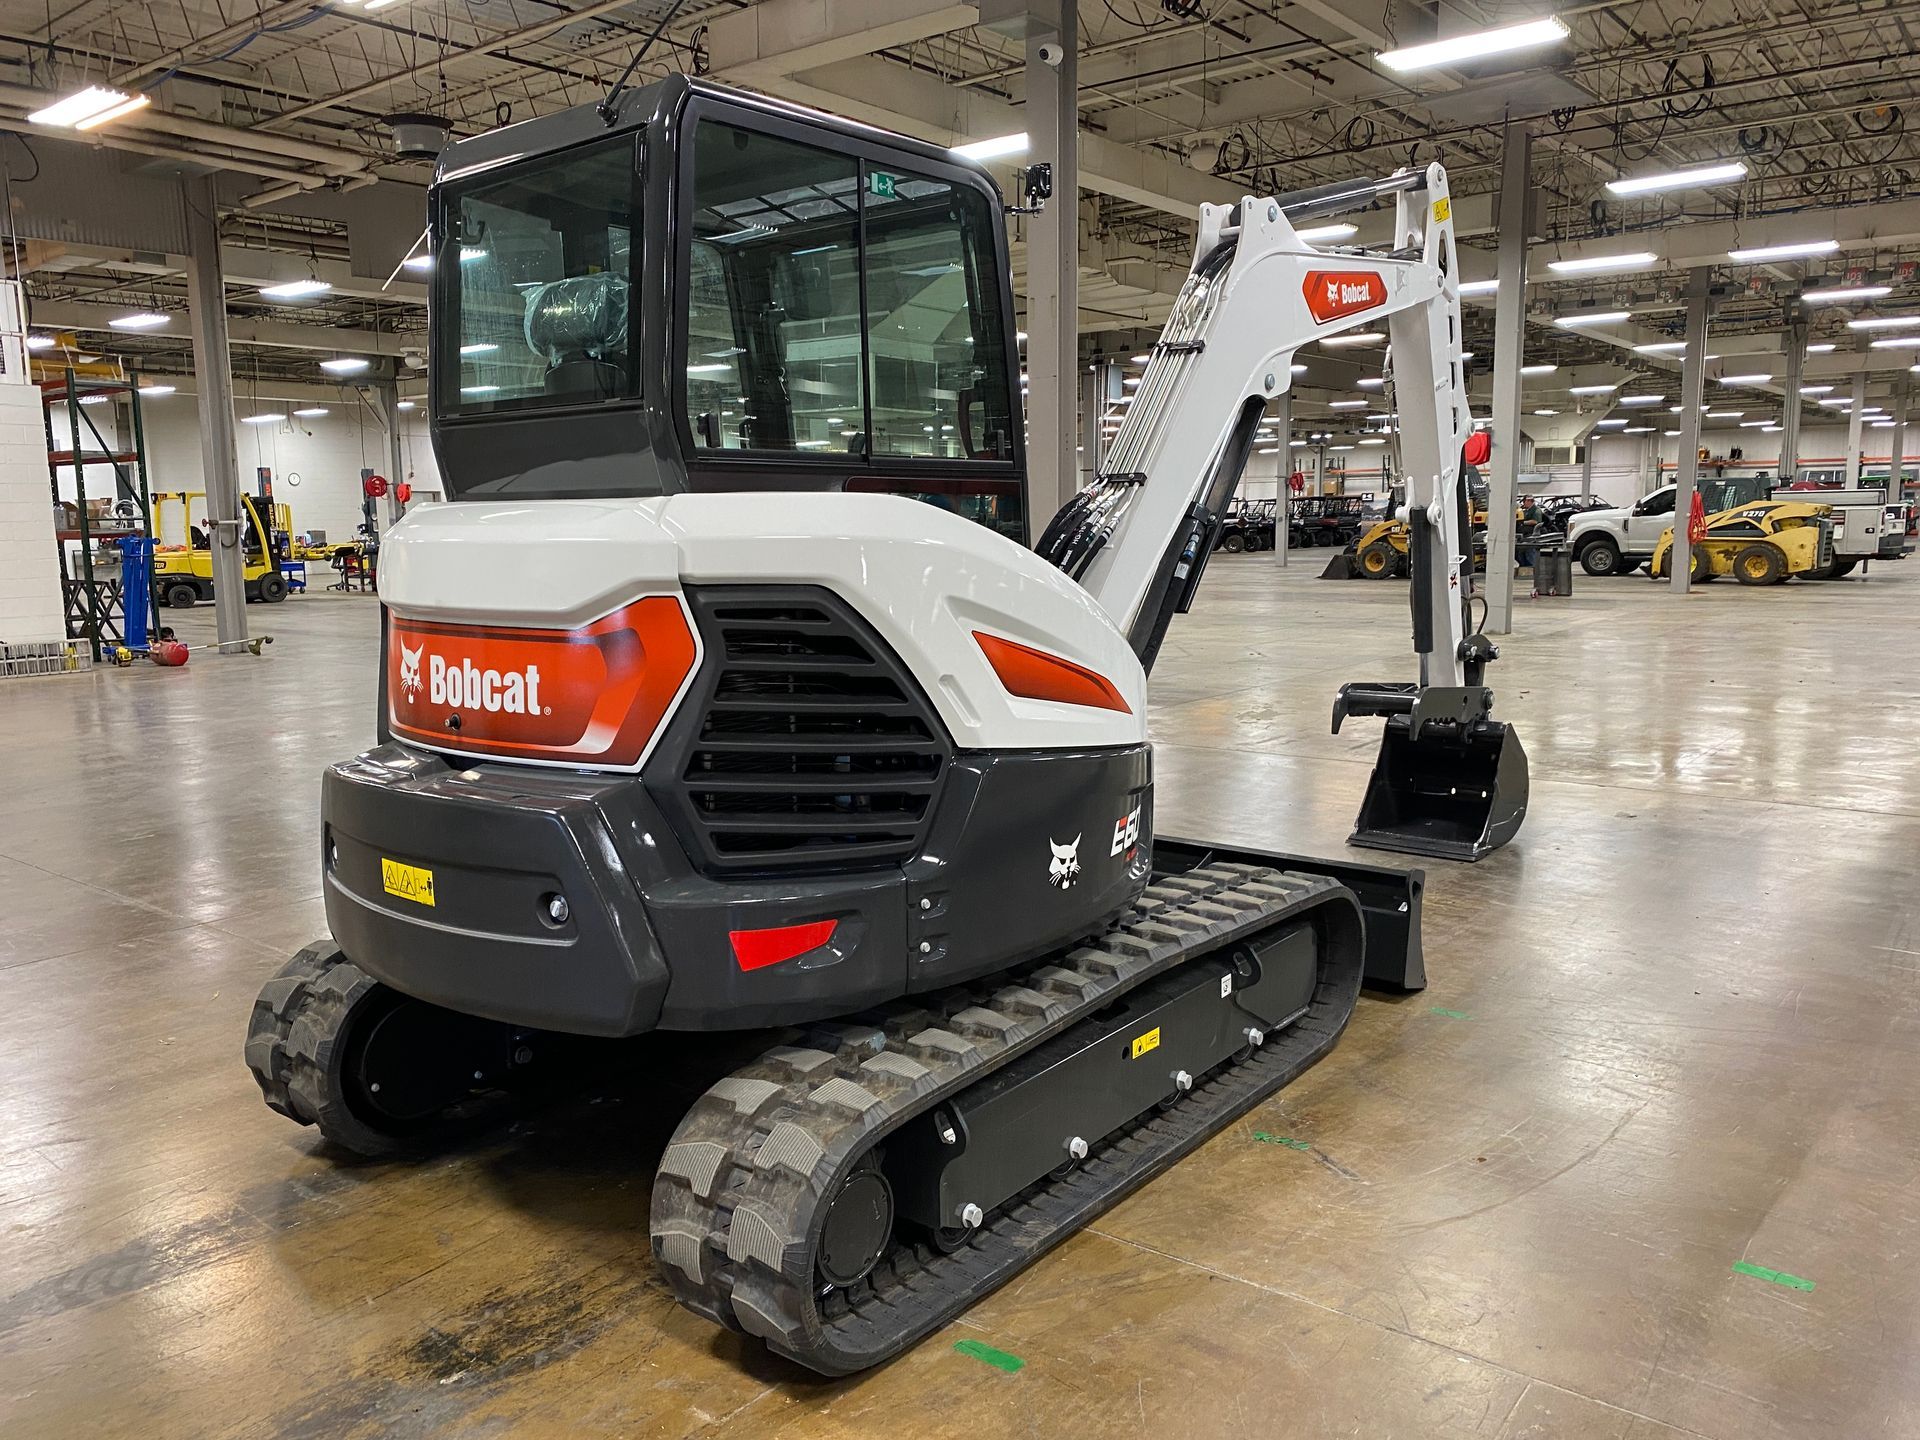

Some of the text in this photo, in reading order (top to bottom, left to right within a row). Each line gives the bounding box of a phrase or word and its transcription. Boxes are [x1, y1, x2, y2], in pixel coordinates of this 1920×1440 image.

[1341, 281, 1370, 304] Bobcat
[1616, 294, 1627, 304] 93
[1660, 290, 1671, 299] 95
[429, 654, 541, 716] Bobcat
[1110, 804, 1142, 857] E60
